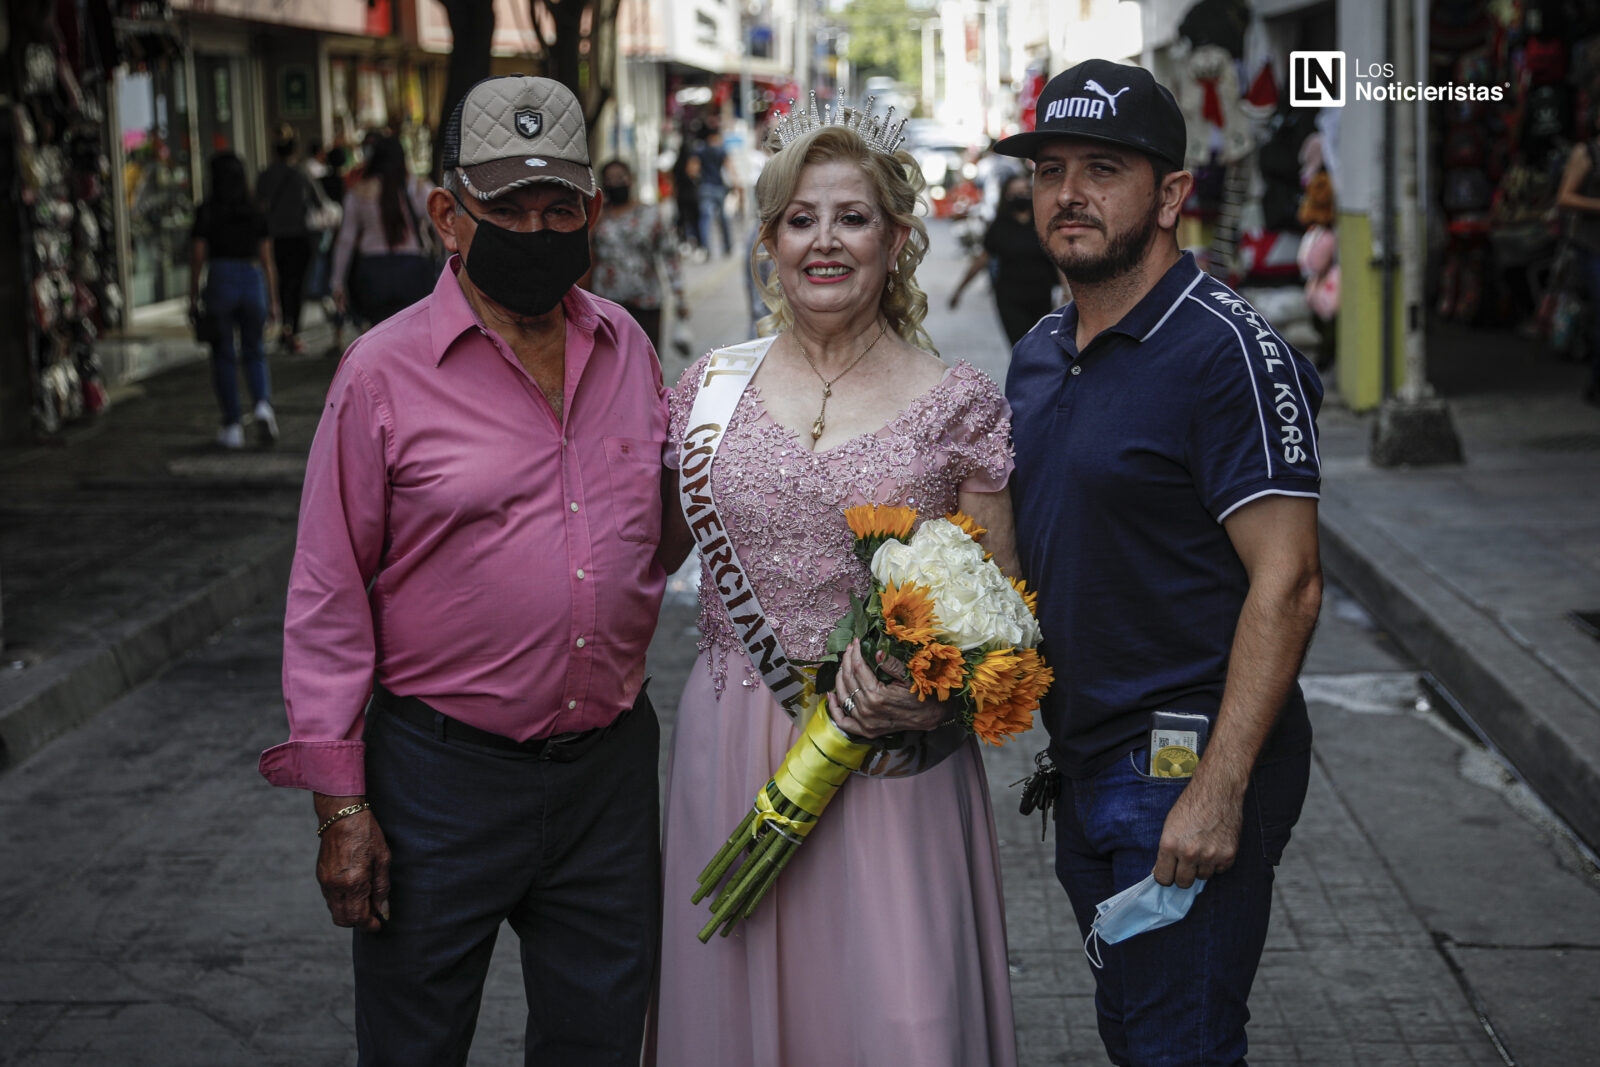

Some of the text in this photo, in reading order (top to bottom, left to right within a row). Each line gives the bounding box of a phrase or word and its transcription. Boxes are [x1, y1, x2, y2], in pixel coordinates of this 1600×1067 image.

[1044, 97, 1106, 123] PUMA
[1273, 382, 1307, 464] KORS
[682, 423, 815, 718] COMERCIANTE
